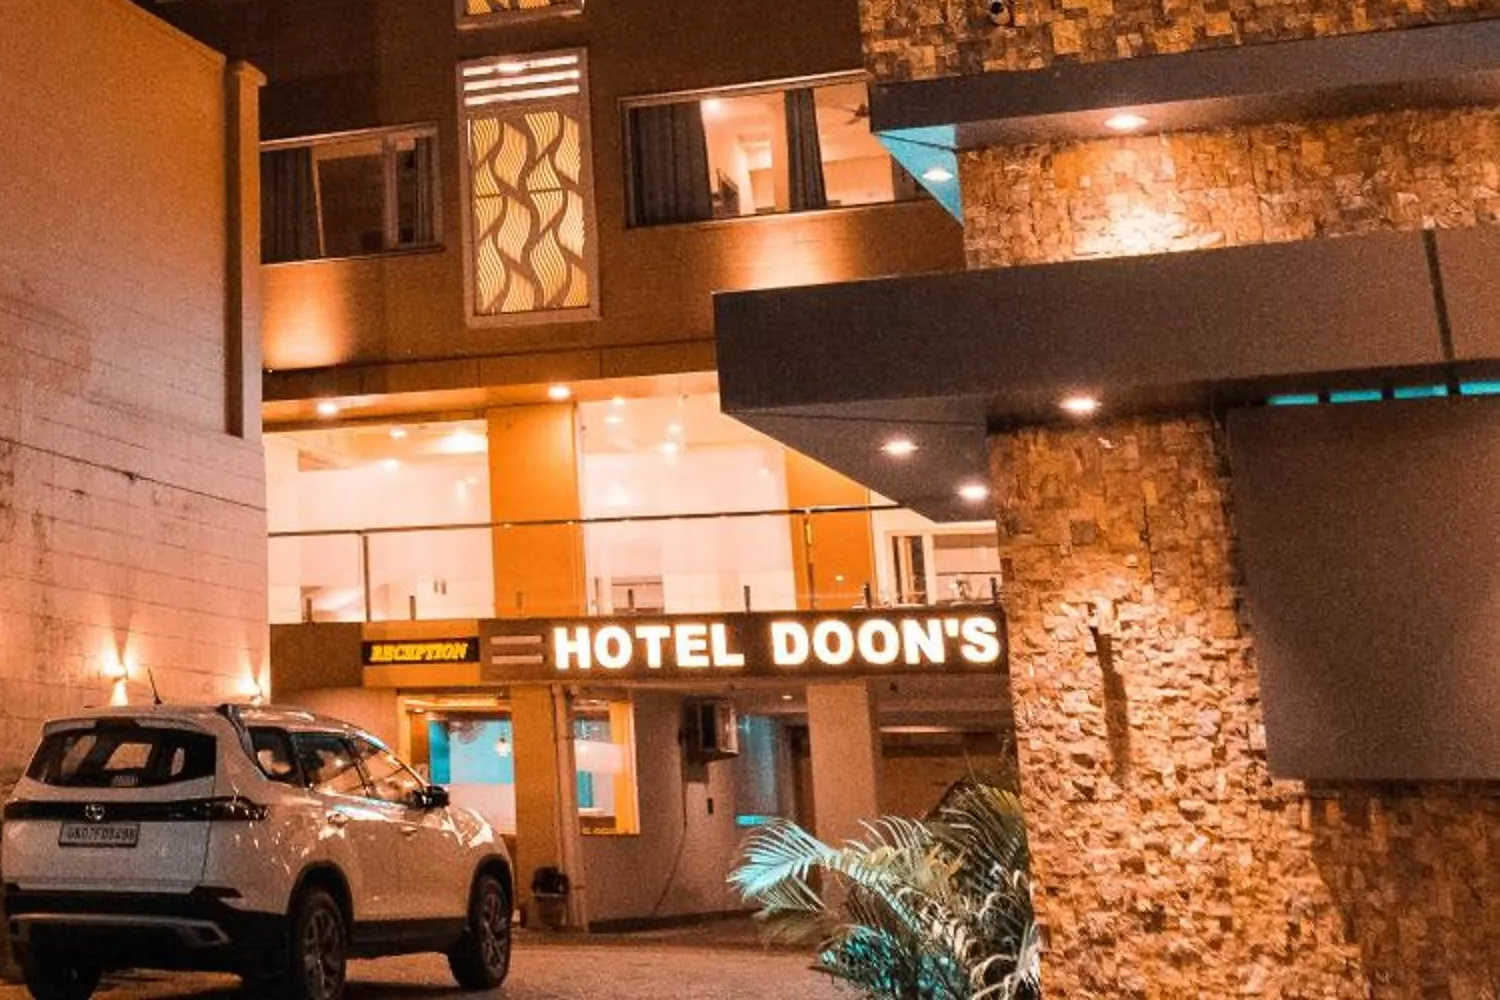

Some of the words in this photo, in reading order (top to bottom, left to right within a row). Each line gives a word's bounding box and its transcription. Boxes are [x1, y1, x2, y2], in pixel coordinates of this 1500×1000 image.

[369, 641, 469, 663] RECEPTION
[552, 622, 745, 670] HOTEL
[770, 615, 1001, 665] DOON'S
